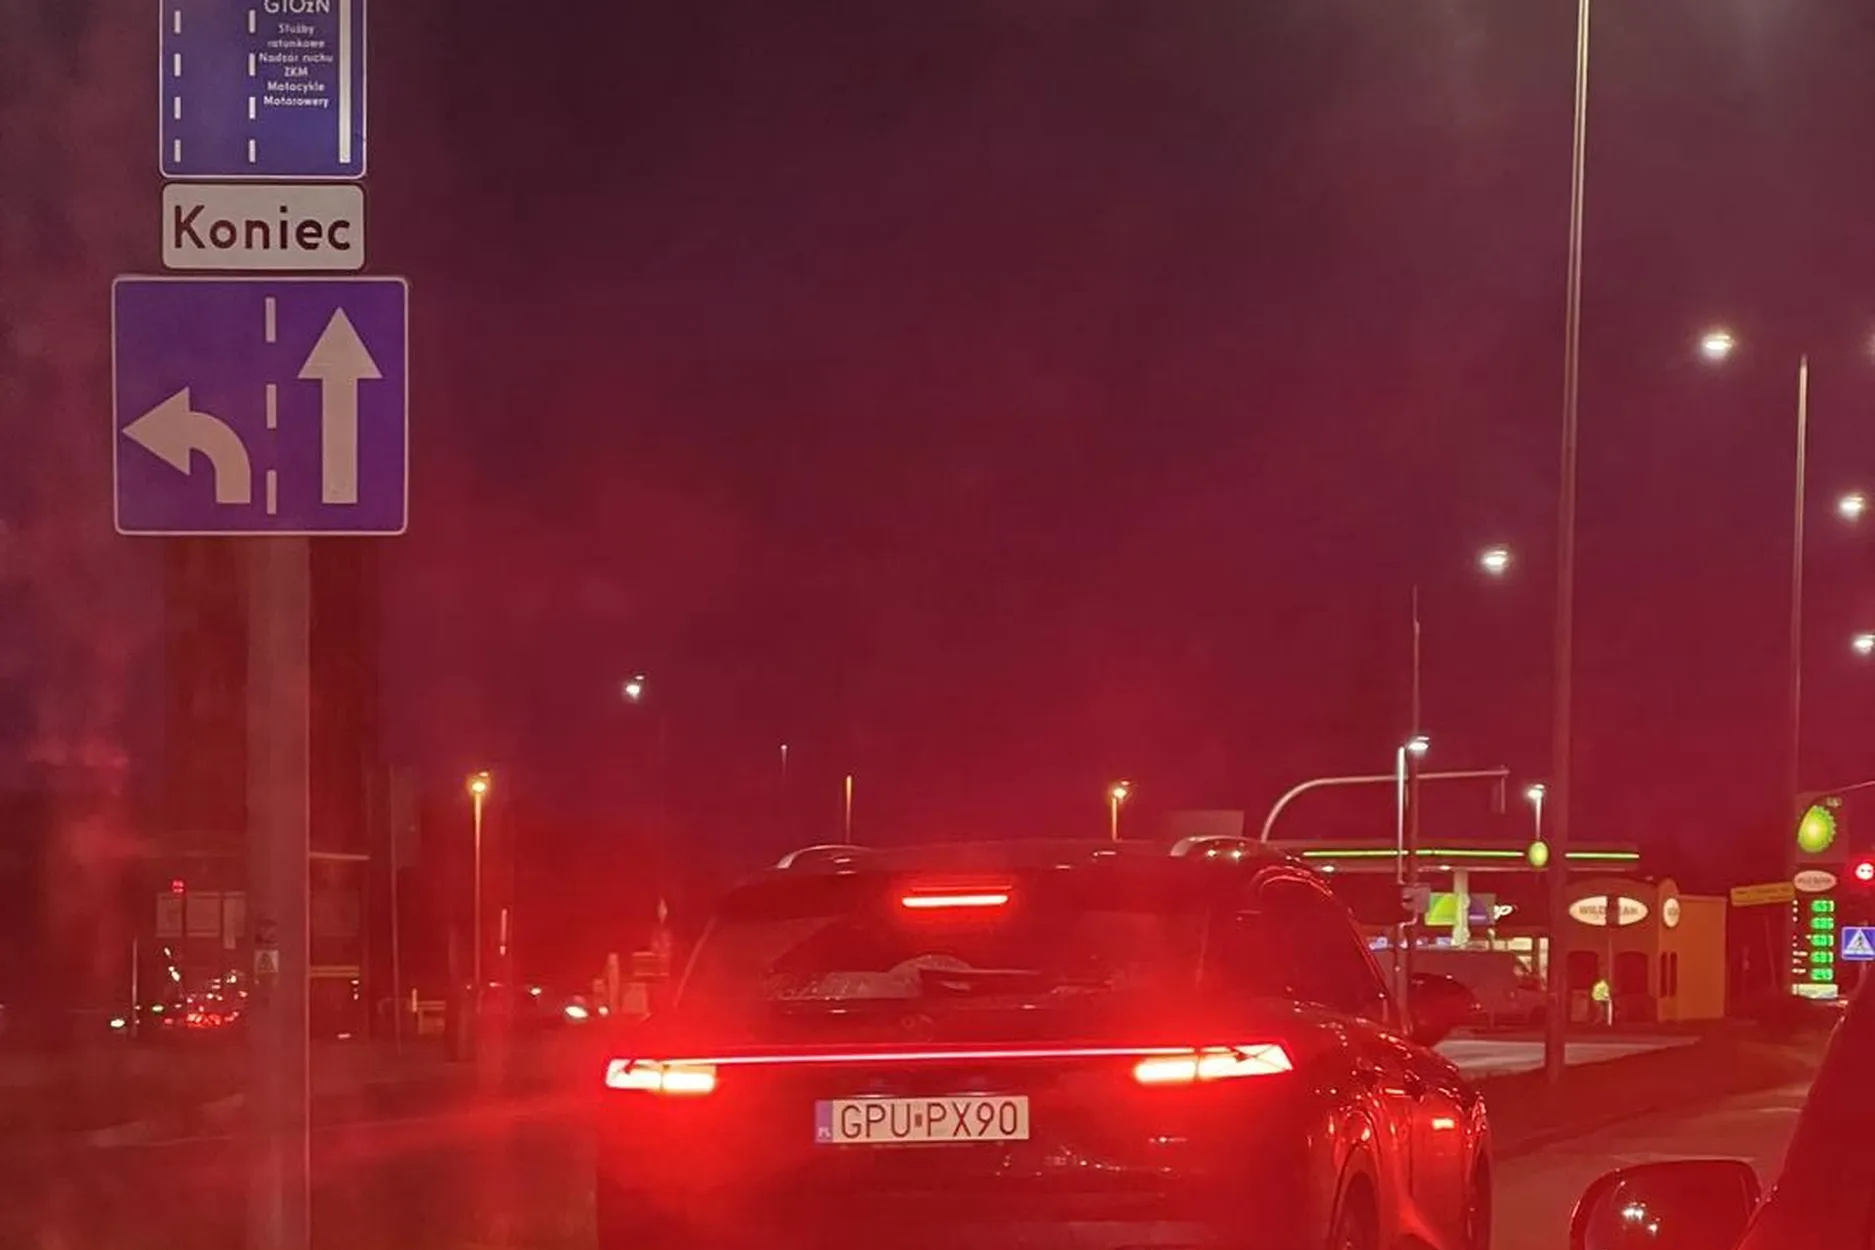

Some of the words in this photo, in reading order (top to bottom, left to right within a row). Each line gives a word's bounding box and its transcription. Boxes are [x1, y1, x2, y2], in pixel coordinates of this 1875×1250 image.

[284, 66, 309, 77] ZKM
[267, 82, 325, 94] Motocykle
[263, 96, 329, 109] Motorowery
[174, 205, 351, 250] Koniec
[841, 1103, 911, 1139] GPU
[926, 1101, 1018, 1138] PX90
